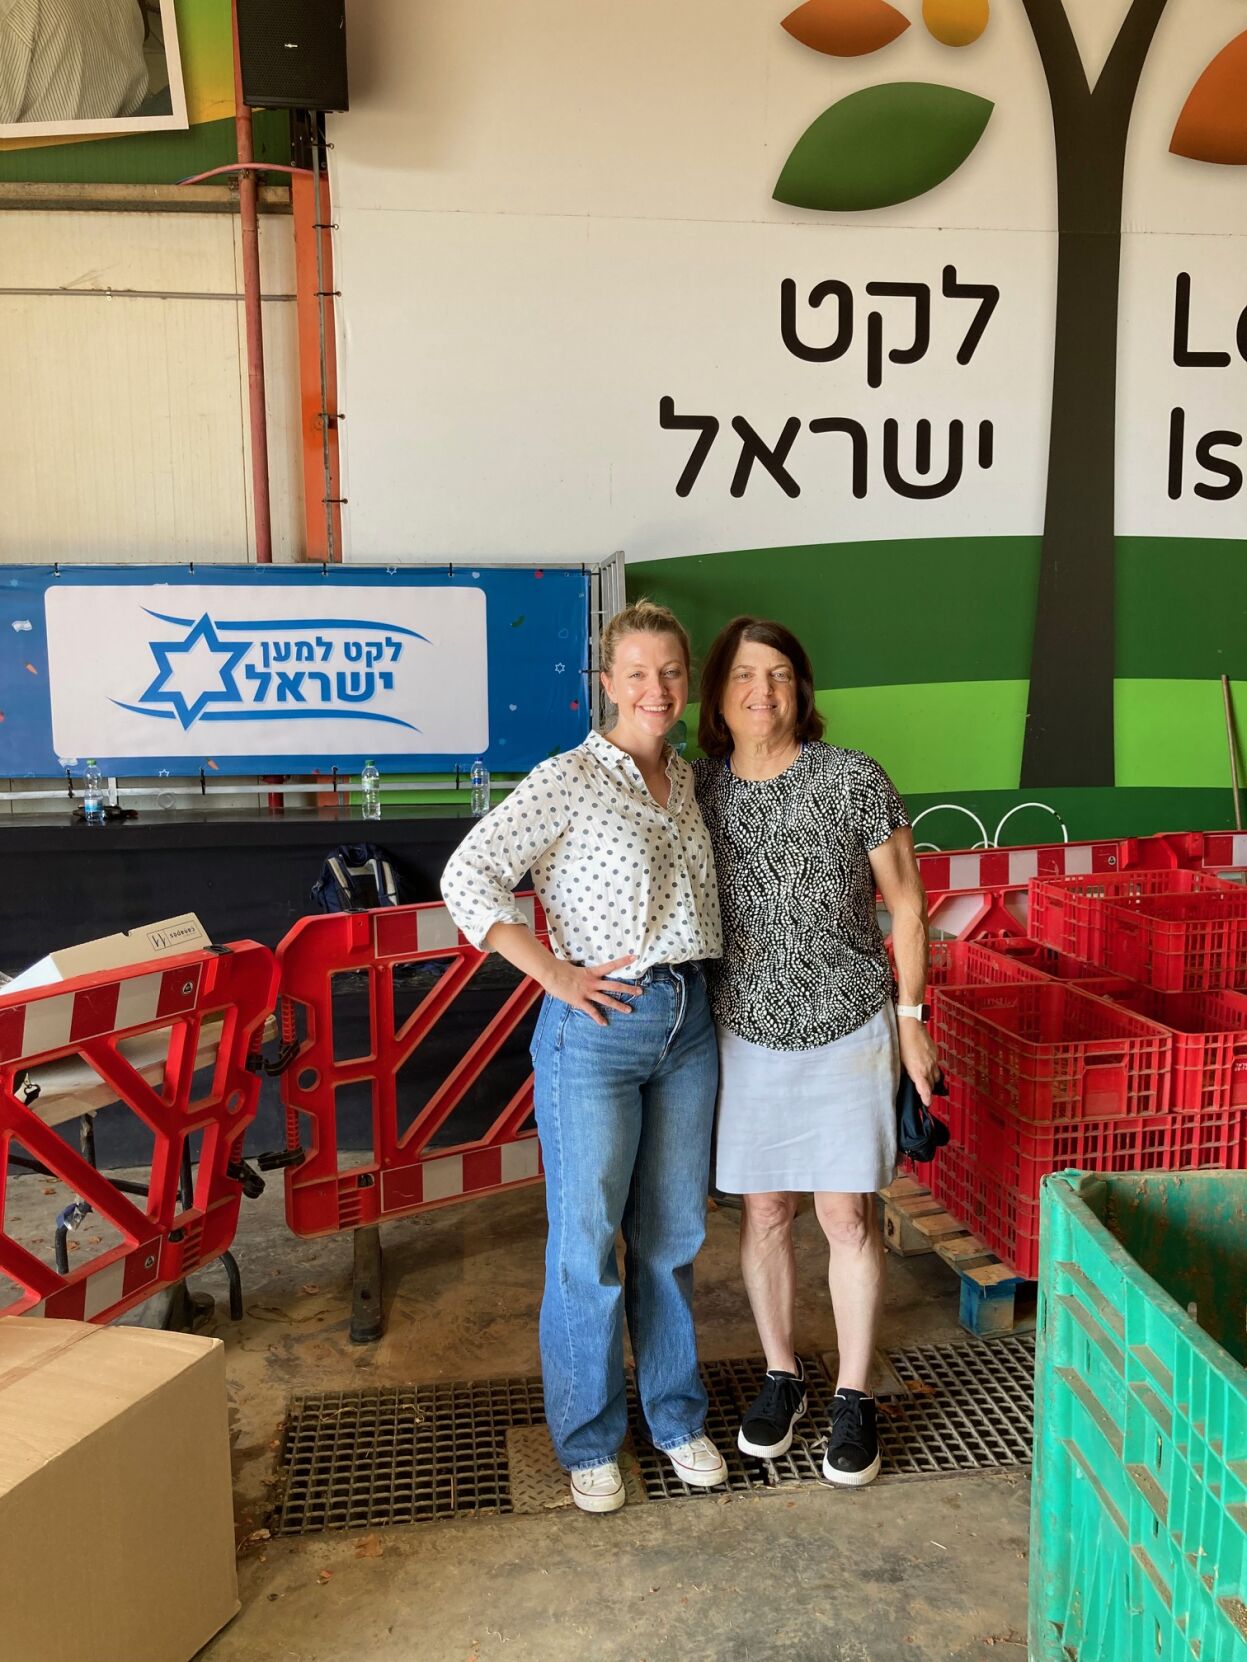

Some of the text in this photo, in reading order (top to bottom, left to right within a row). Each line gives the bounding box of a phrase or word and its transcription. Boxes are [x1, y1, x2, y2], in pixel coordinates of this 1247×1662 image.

[781, 265, 999, 388] לקט
[1173, 272, 1247, 367] L
[660, 396, 993, 499] ישראל
[245, 664, 394, 702] ישראל
[260, 636, 402, 668] לקט למען
